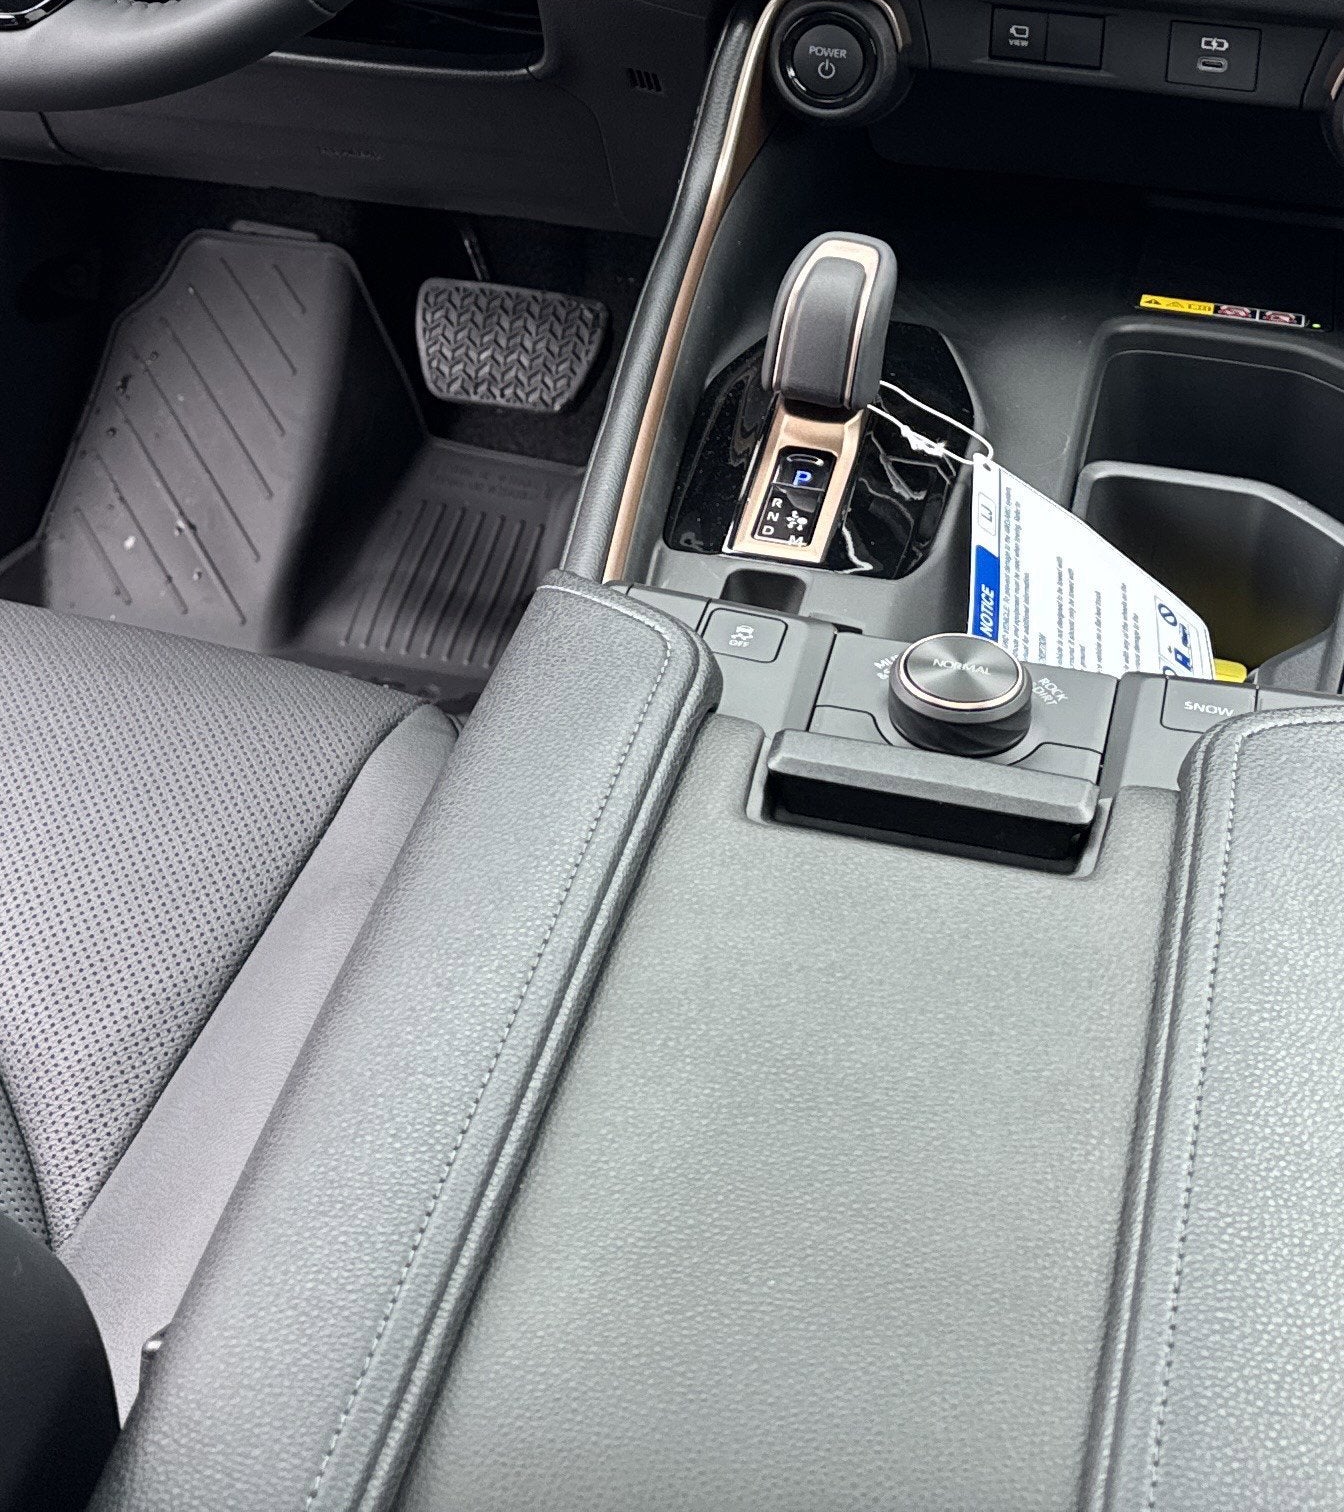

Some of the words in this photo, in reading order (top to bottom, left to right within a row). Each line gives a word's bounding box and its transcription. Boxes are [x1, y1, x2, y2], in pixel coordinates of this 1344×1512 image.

[1008, 38, 1029, 48] VIEW
[809, 45, 847, 59] POWER
[793, 470, 813, 488] P
[771, 497, 783, 508] R
[766, 511, 779, 522] N
[761, 525, 775, 535] D
[788, 535, 804, 547] M
[979, 584, 996, 638] NOTICE
[729, 639, 750, 648] OFF
[932, 657, 992, 677] NORMAL
[1038, 677, 1068, 702] ROCK
[1183, 701, 1235, 717] SNOW
